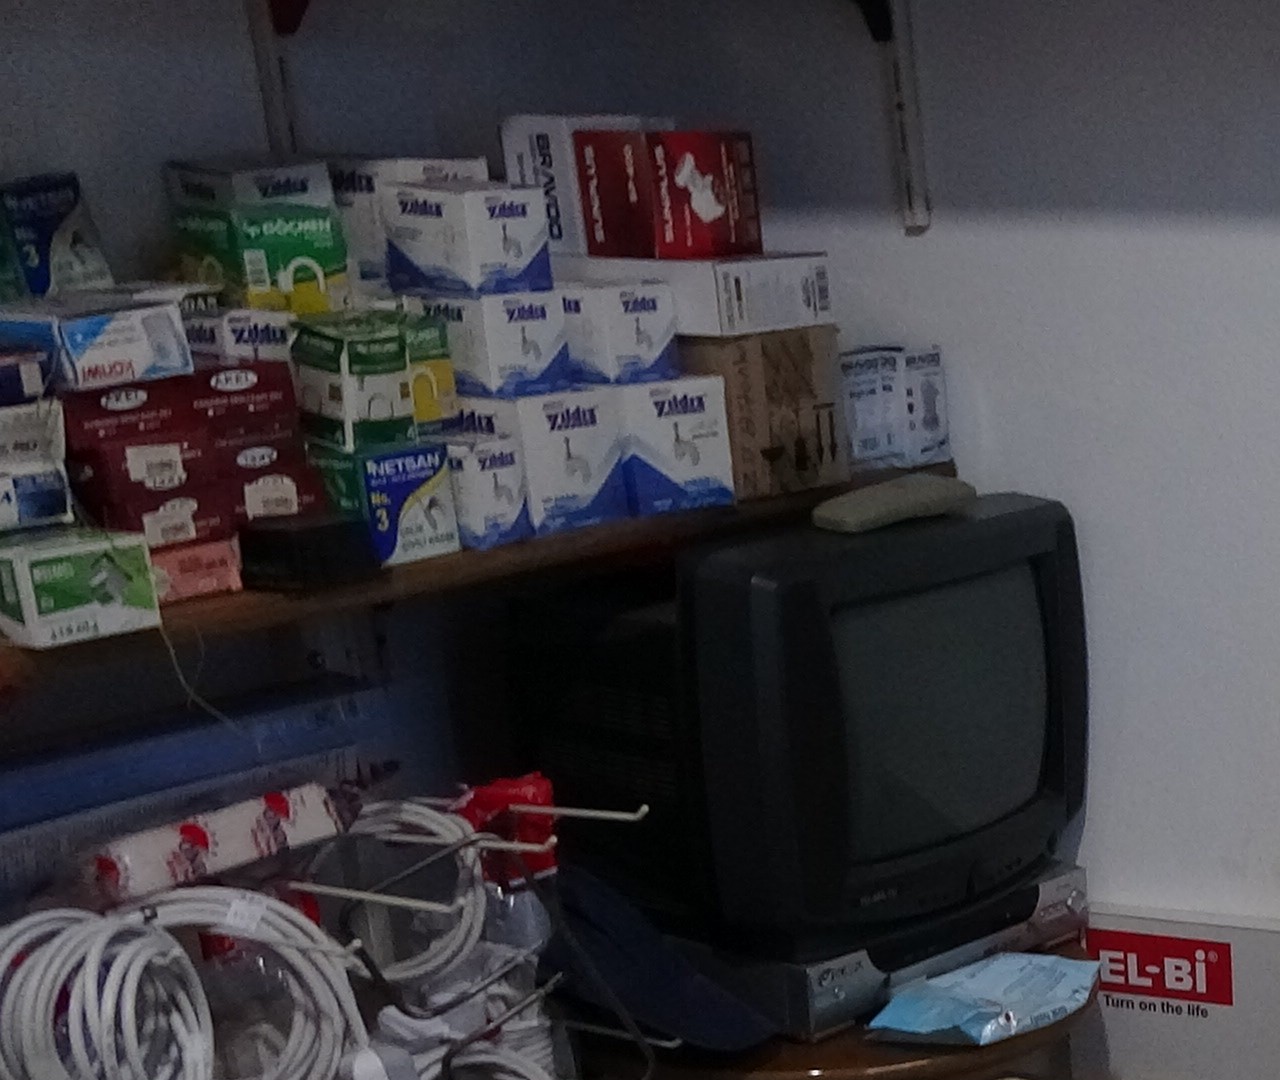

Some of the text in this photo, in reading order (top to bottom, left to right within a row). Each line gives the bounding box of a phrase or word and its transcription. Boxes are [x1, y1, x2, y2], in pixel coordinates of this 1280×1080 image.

[1104, 995, 1209, 1018] Turn on the life
